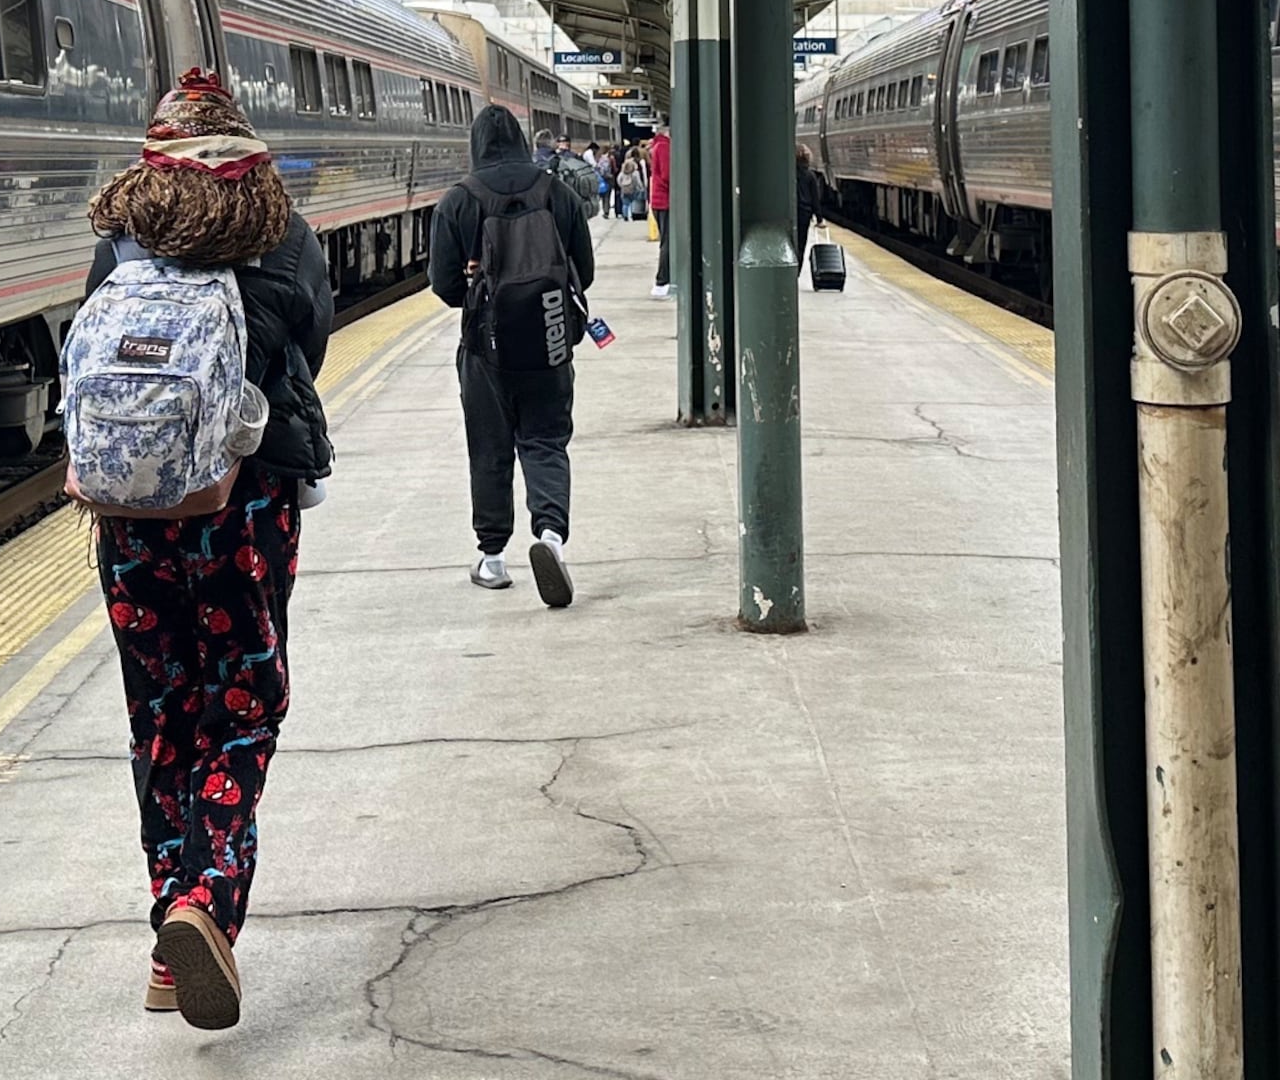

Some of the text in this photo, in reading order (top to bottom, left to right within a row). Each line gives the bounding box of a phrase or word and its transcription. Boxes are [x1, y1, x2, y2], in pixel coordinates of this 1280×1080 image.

[793, 40, 827, 51] tation
[561, 53, 601, 63] Location
[541, 289, 567, 367] arena
[122, 340, 169, 357] trans
